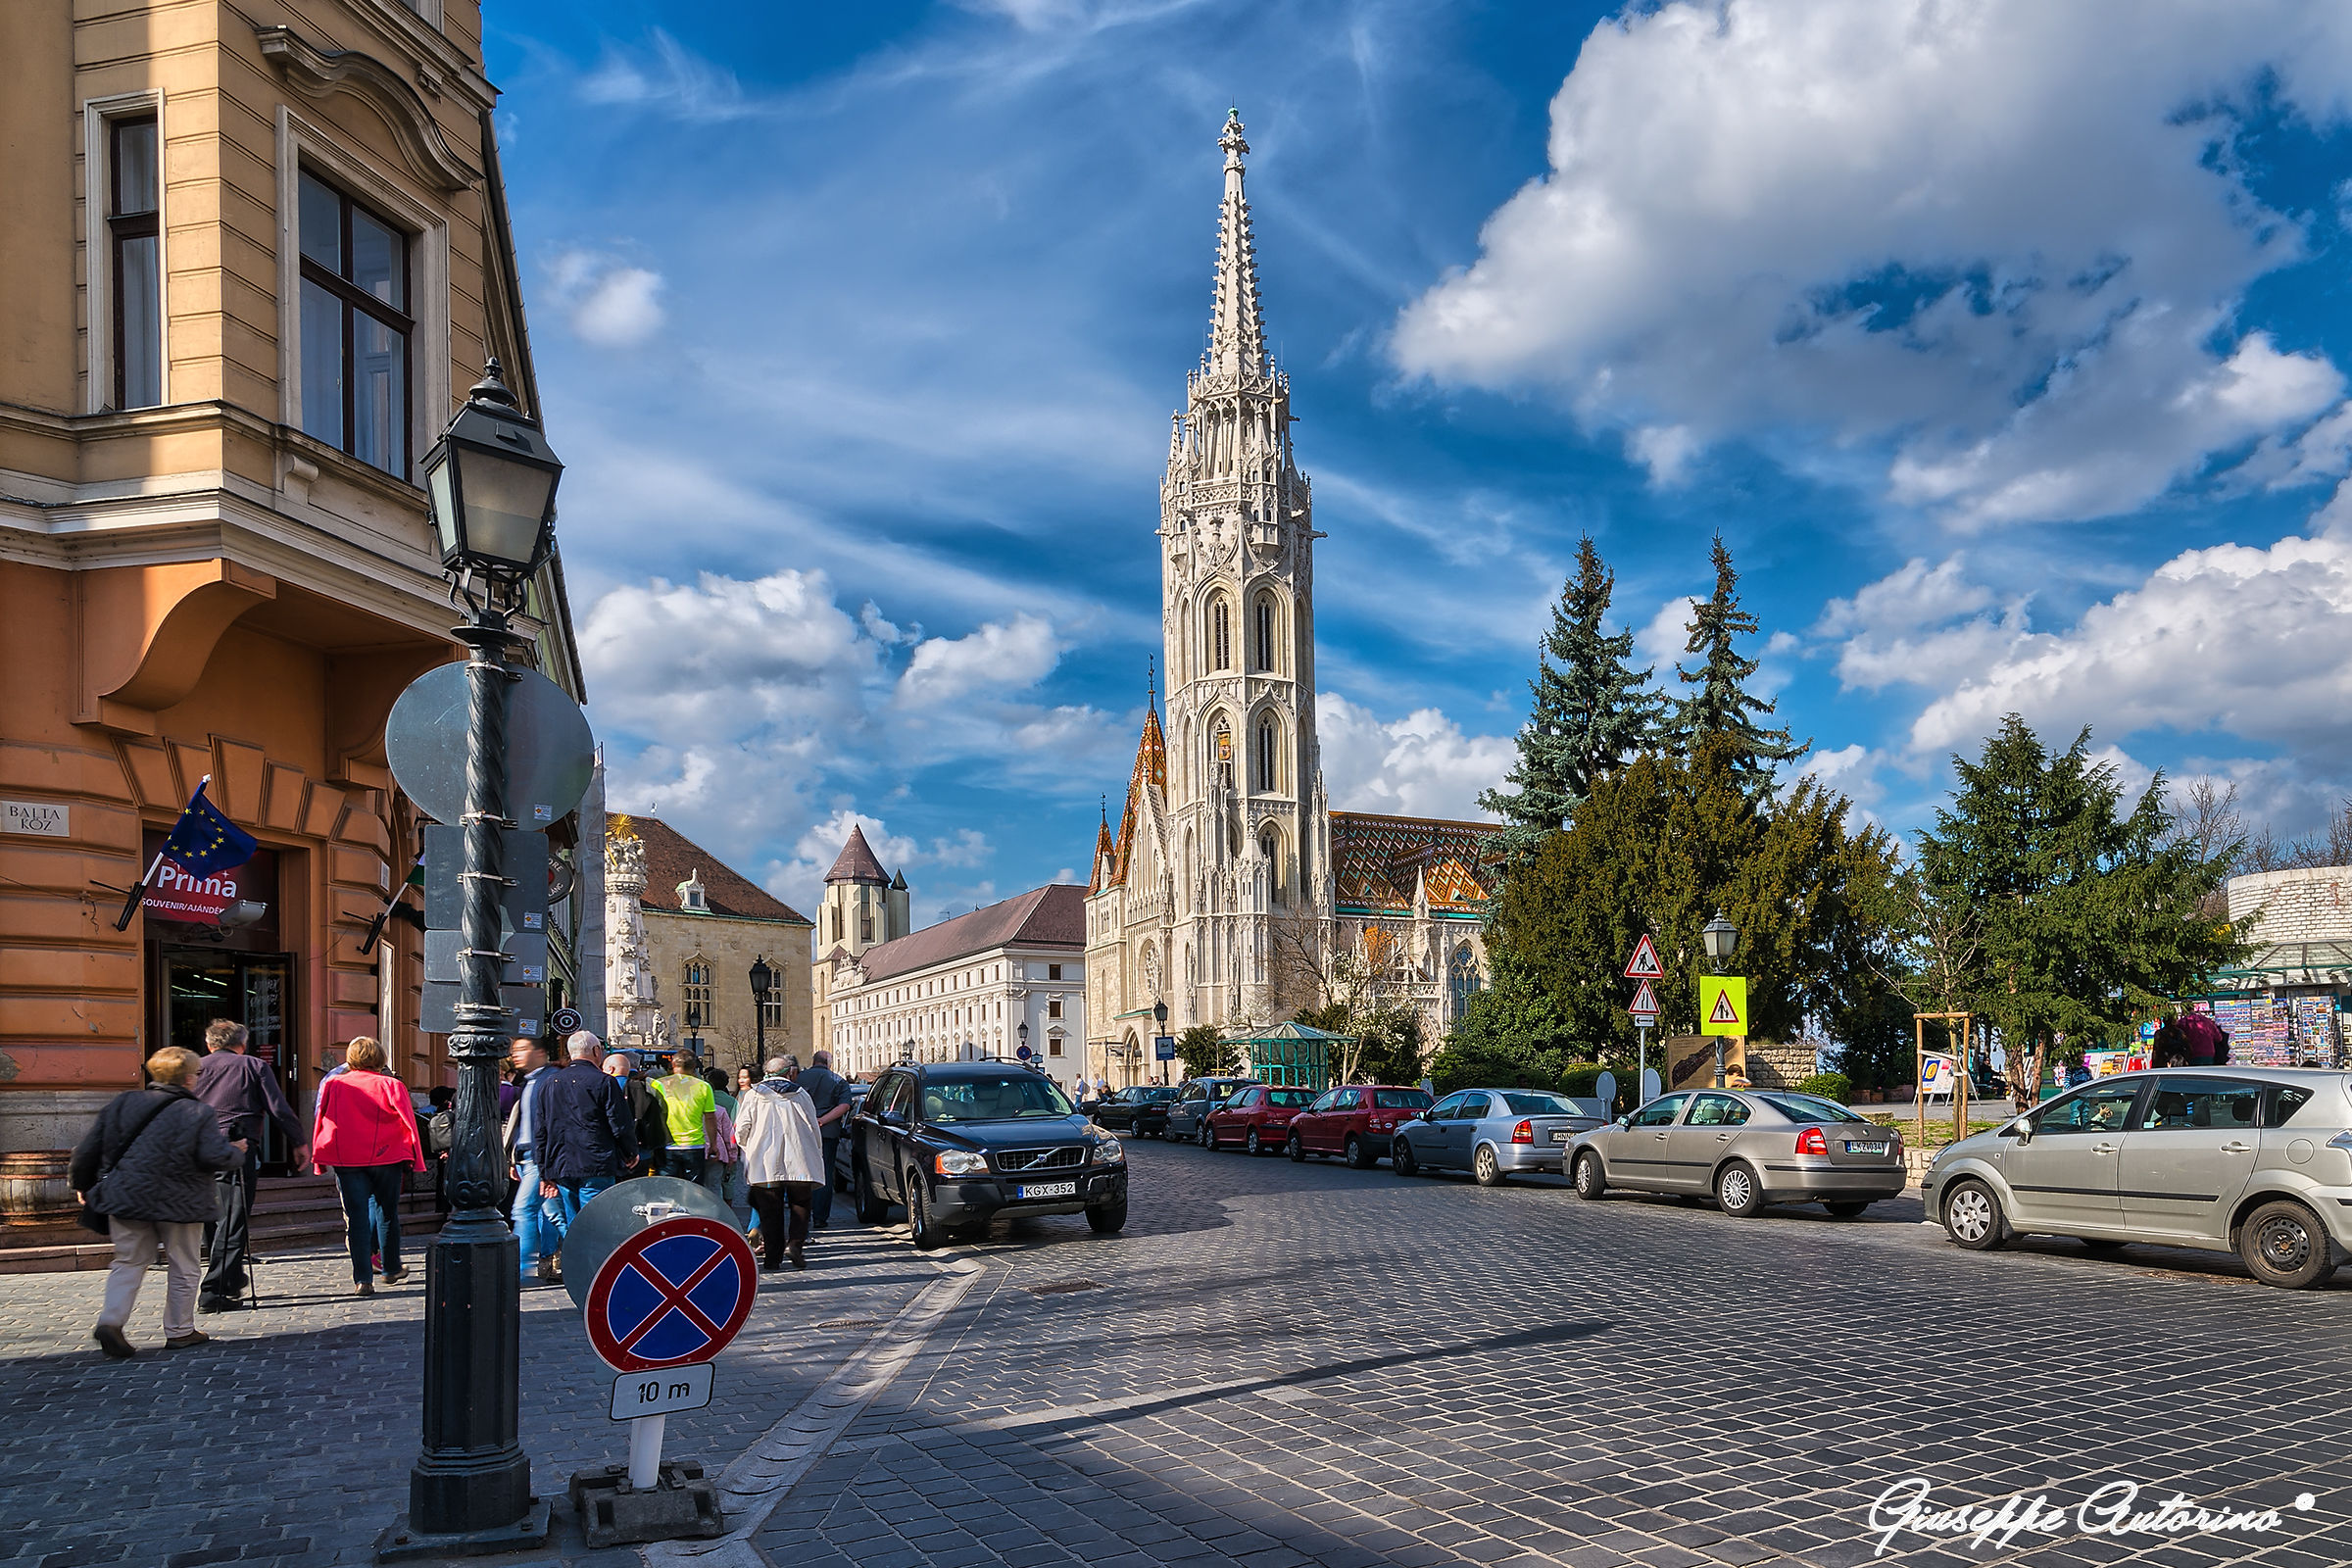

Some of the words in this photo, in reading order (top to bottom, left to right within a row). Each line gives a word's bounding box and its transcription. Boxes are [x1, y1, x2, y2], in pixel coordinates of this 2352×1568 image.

[10, 806, 61, 820] BALTA
[157, 864, 238, 899] Prima
[1025, 1183, 1074, 1197] KGX-352
[637, 1381, 661, 1404] 10
[667, 1382, 691, 1399] m
